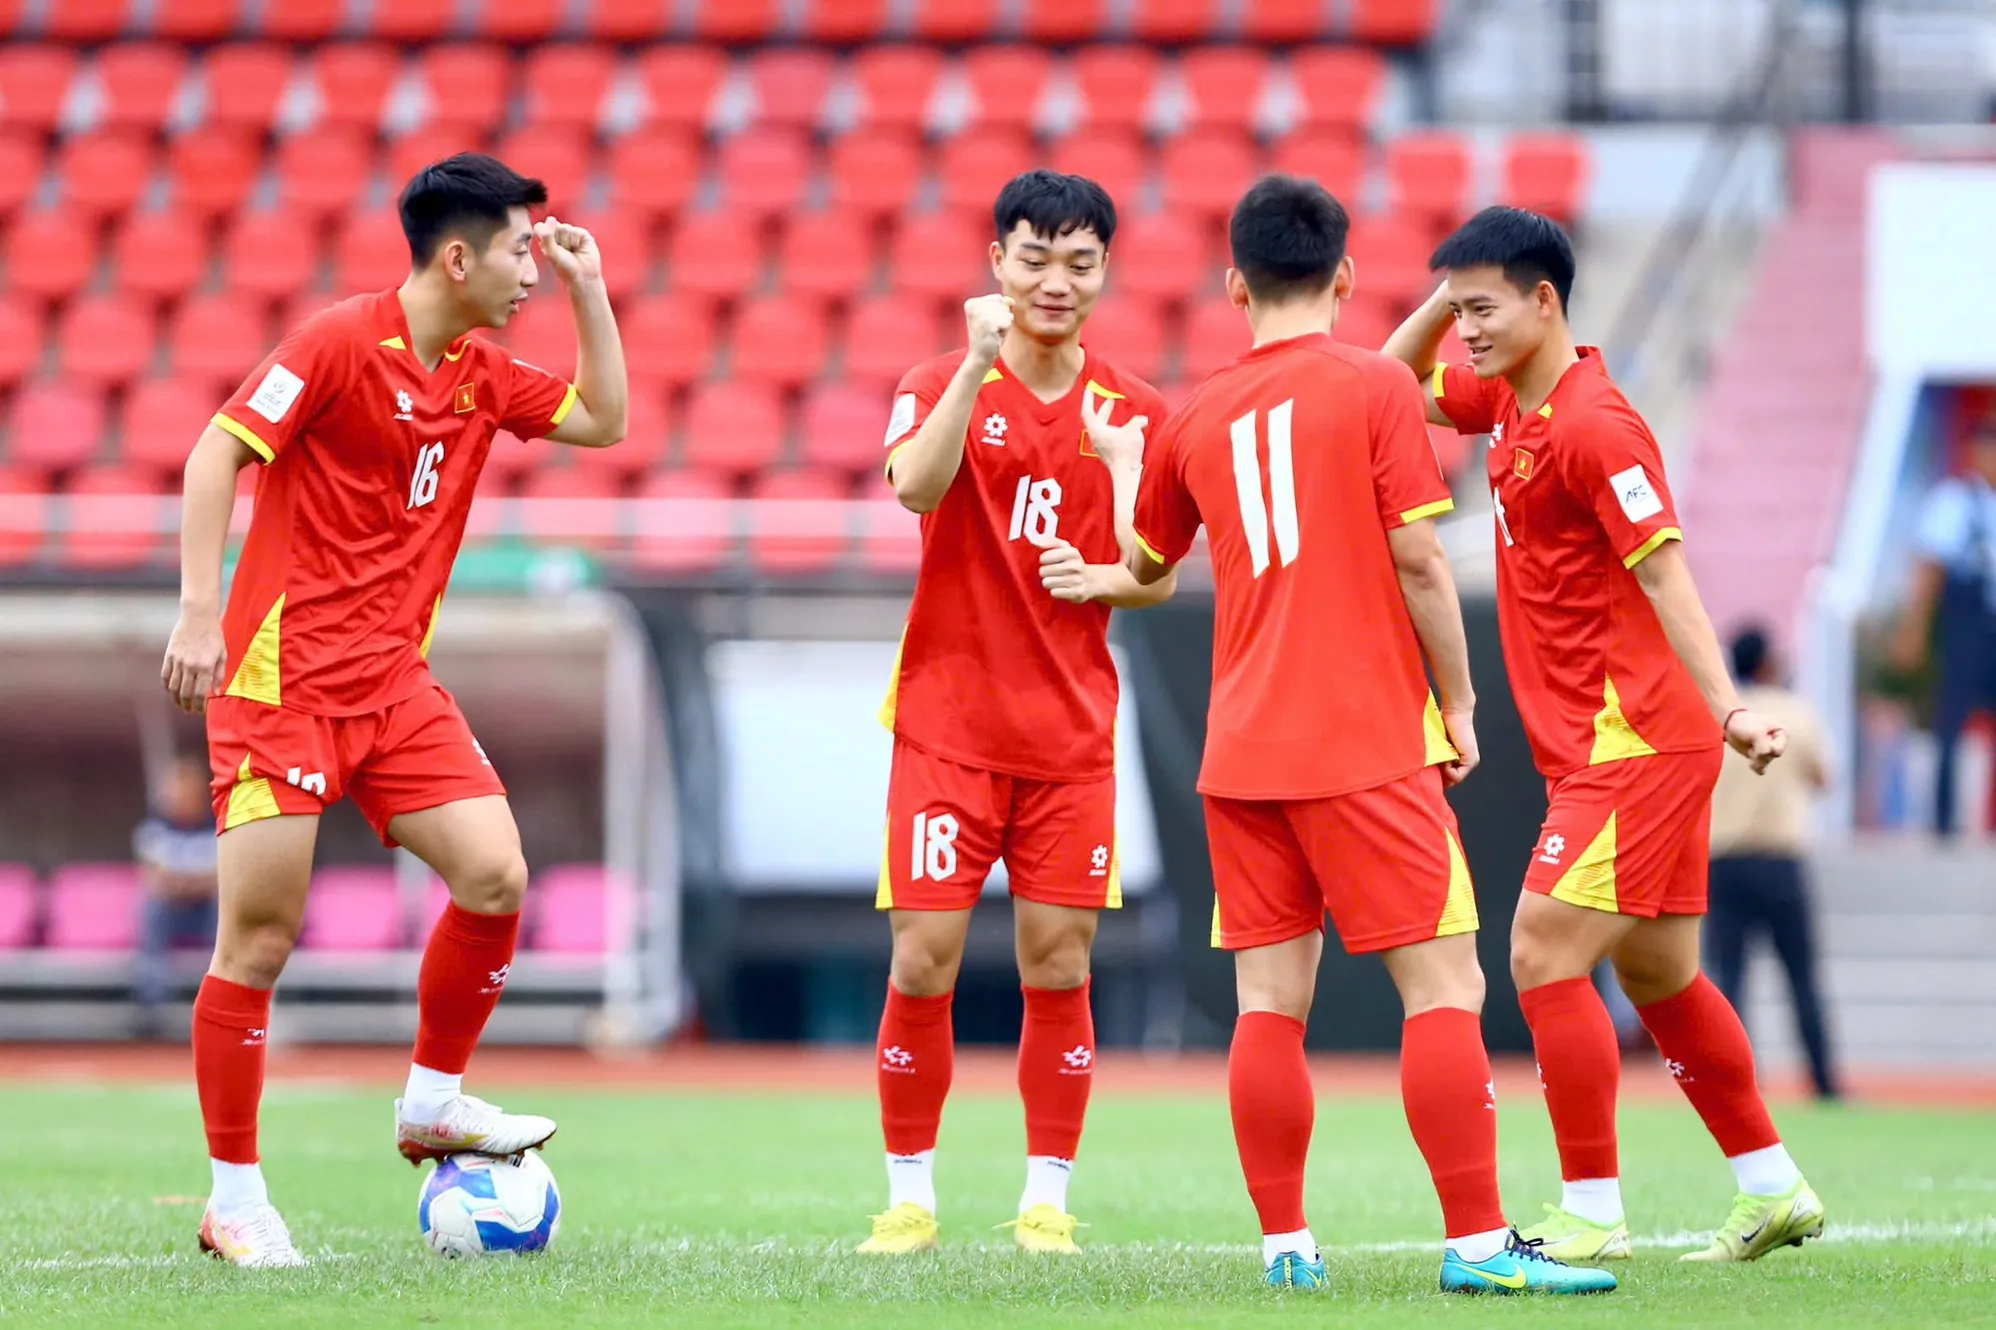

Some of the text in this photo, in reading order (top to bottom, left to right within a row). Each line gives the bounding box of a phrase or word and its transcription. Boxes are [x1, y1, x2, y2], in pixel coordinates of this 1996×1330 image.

[407, 441, 444, 510] 16
[1229, 397, 1300, 579] 11
[1625, 484, 1647, 504] AFC
[1008, 474, 1062, 549] 18
[911, 811, 960, 882] 18
